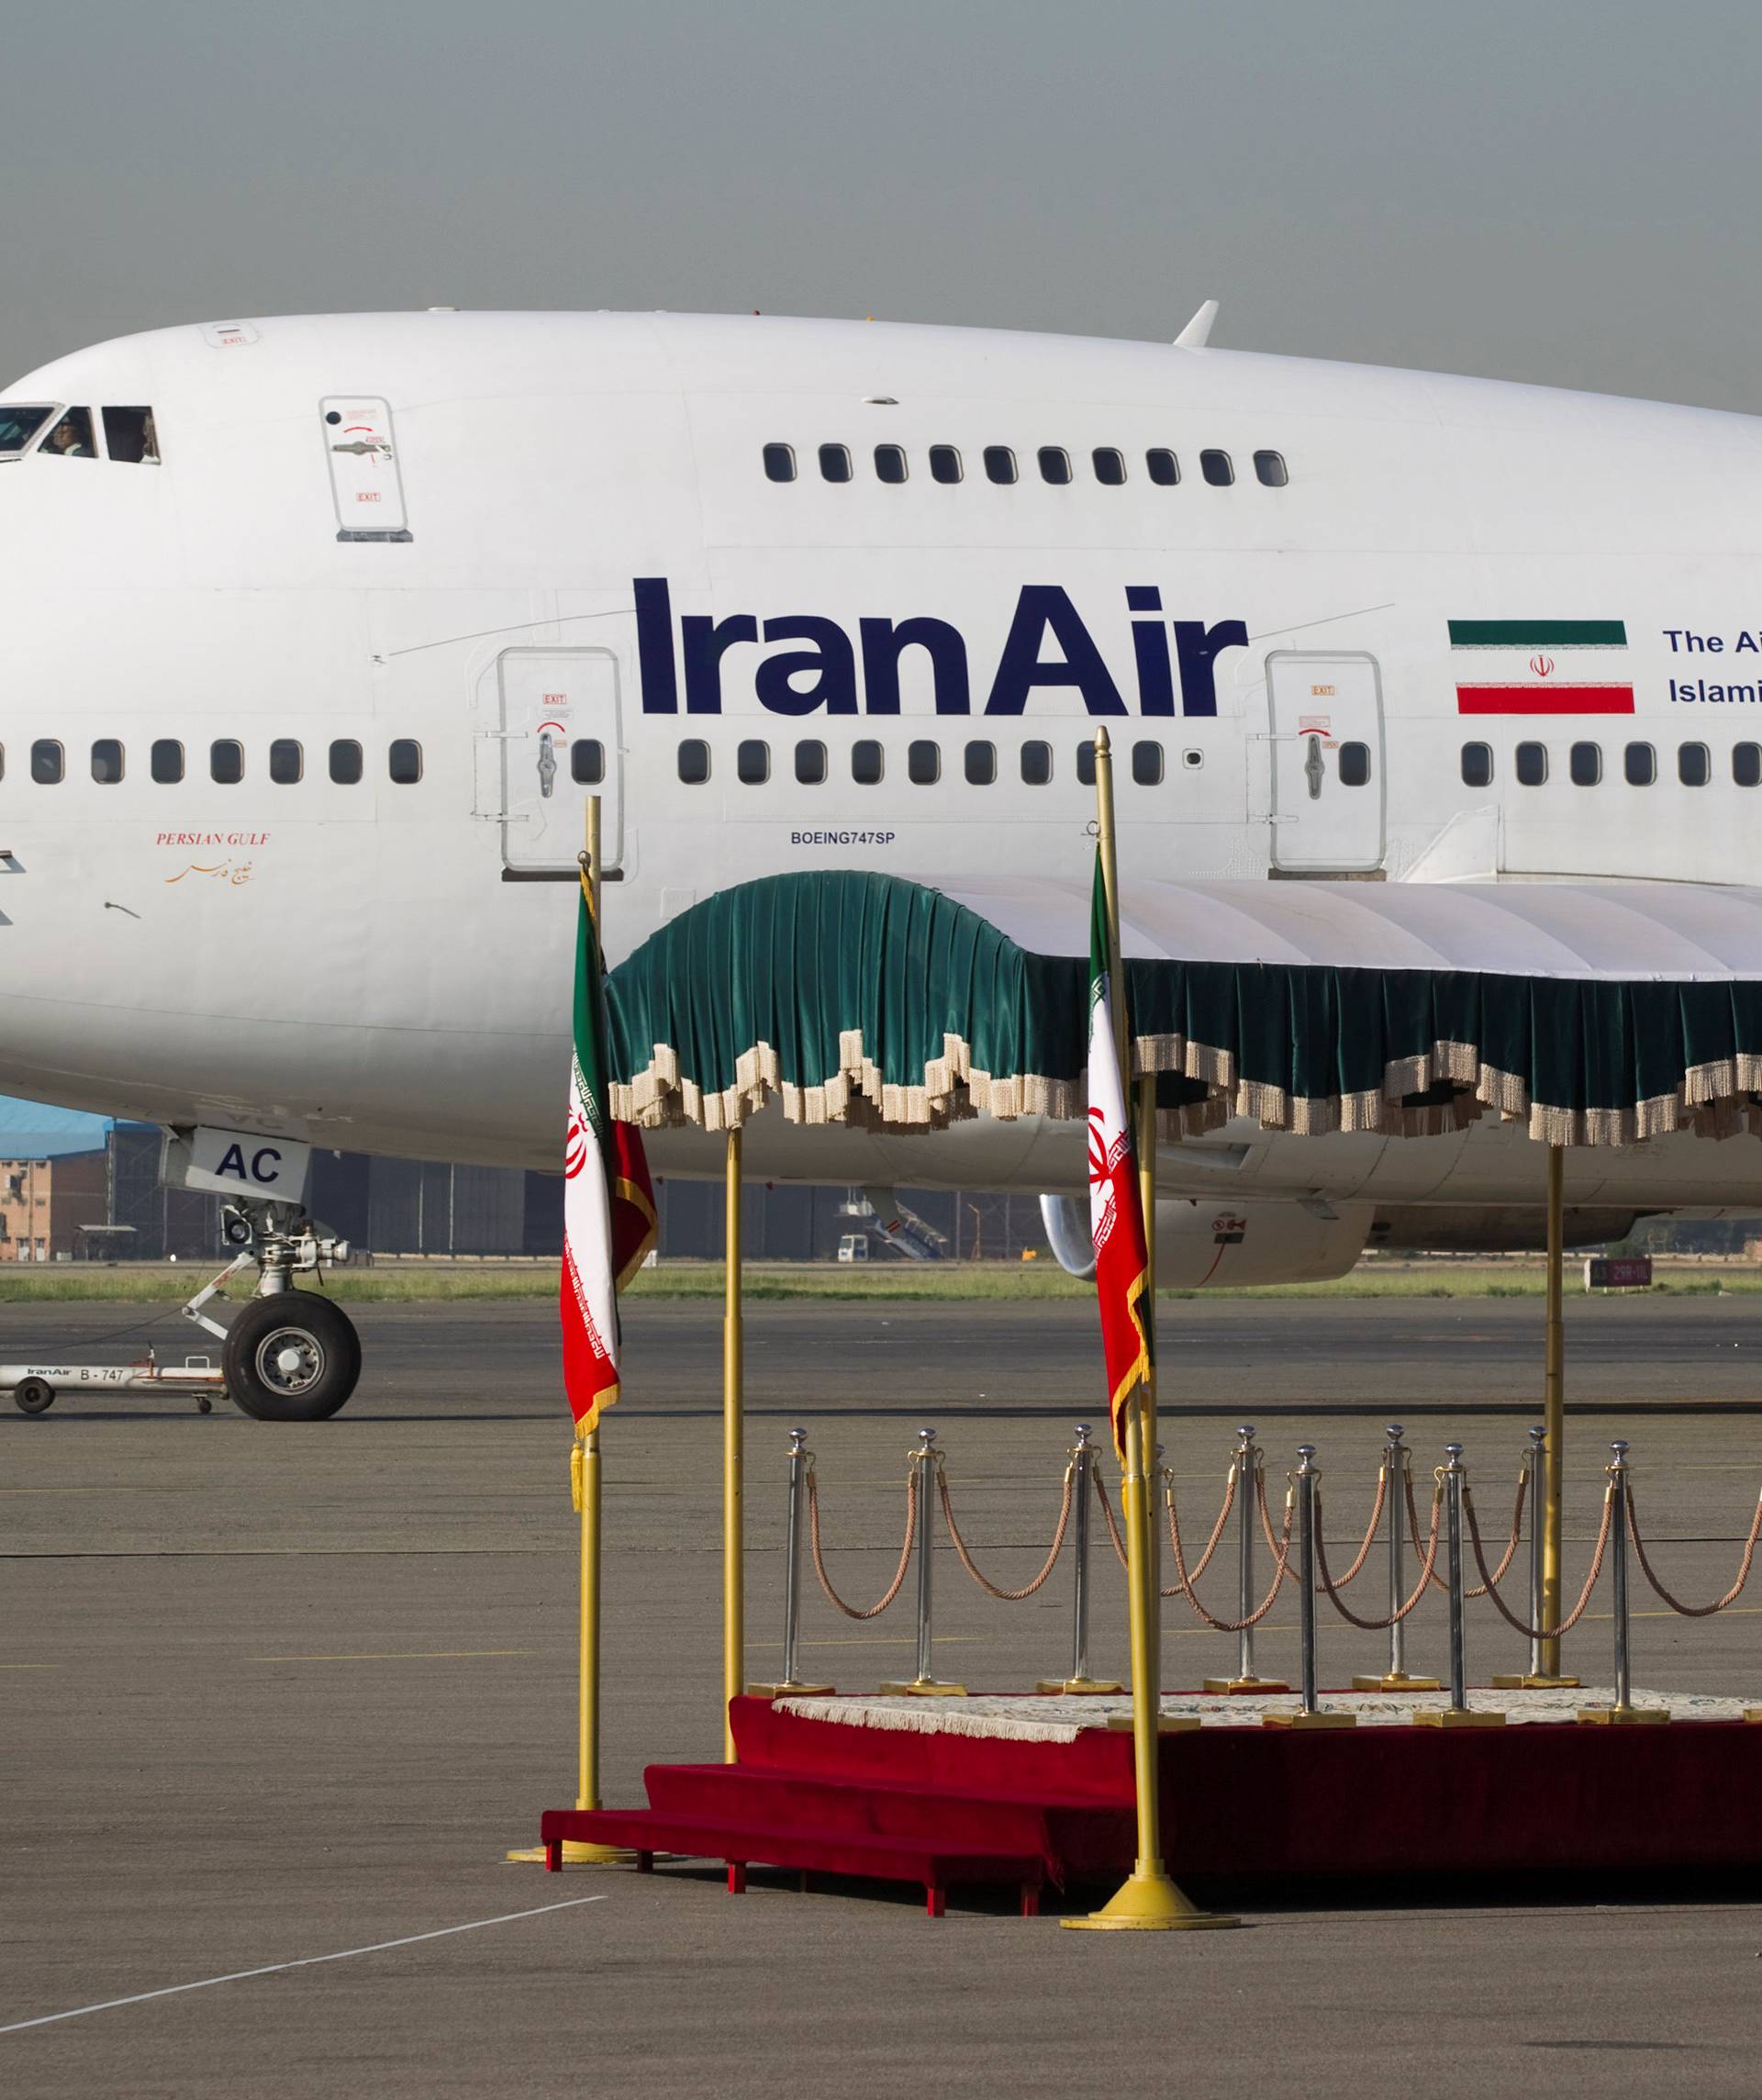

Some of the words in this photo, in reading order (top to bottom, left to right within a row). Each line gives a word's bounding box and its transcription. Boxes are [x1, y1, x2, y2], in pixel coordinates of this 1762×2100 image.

[358, 493, 379, 501] EXIT
[1663, 631, 1723, 653] The
[1312, 686, 1333, 696] EXIT
[544, 694, 564, 705] EXIT
[156, 832, 224, 845] PERSIAN
[227, 832, 272, 845] GULF
[791, 832, 896, 844] BOEING747SP
[215, 1144, 282, 1183] AC
[81, 1369, 90, 1380] B
[102, 1369, 124, 1380] 747
